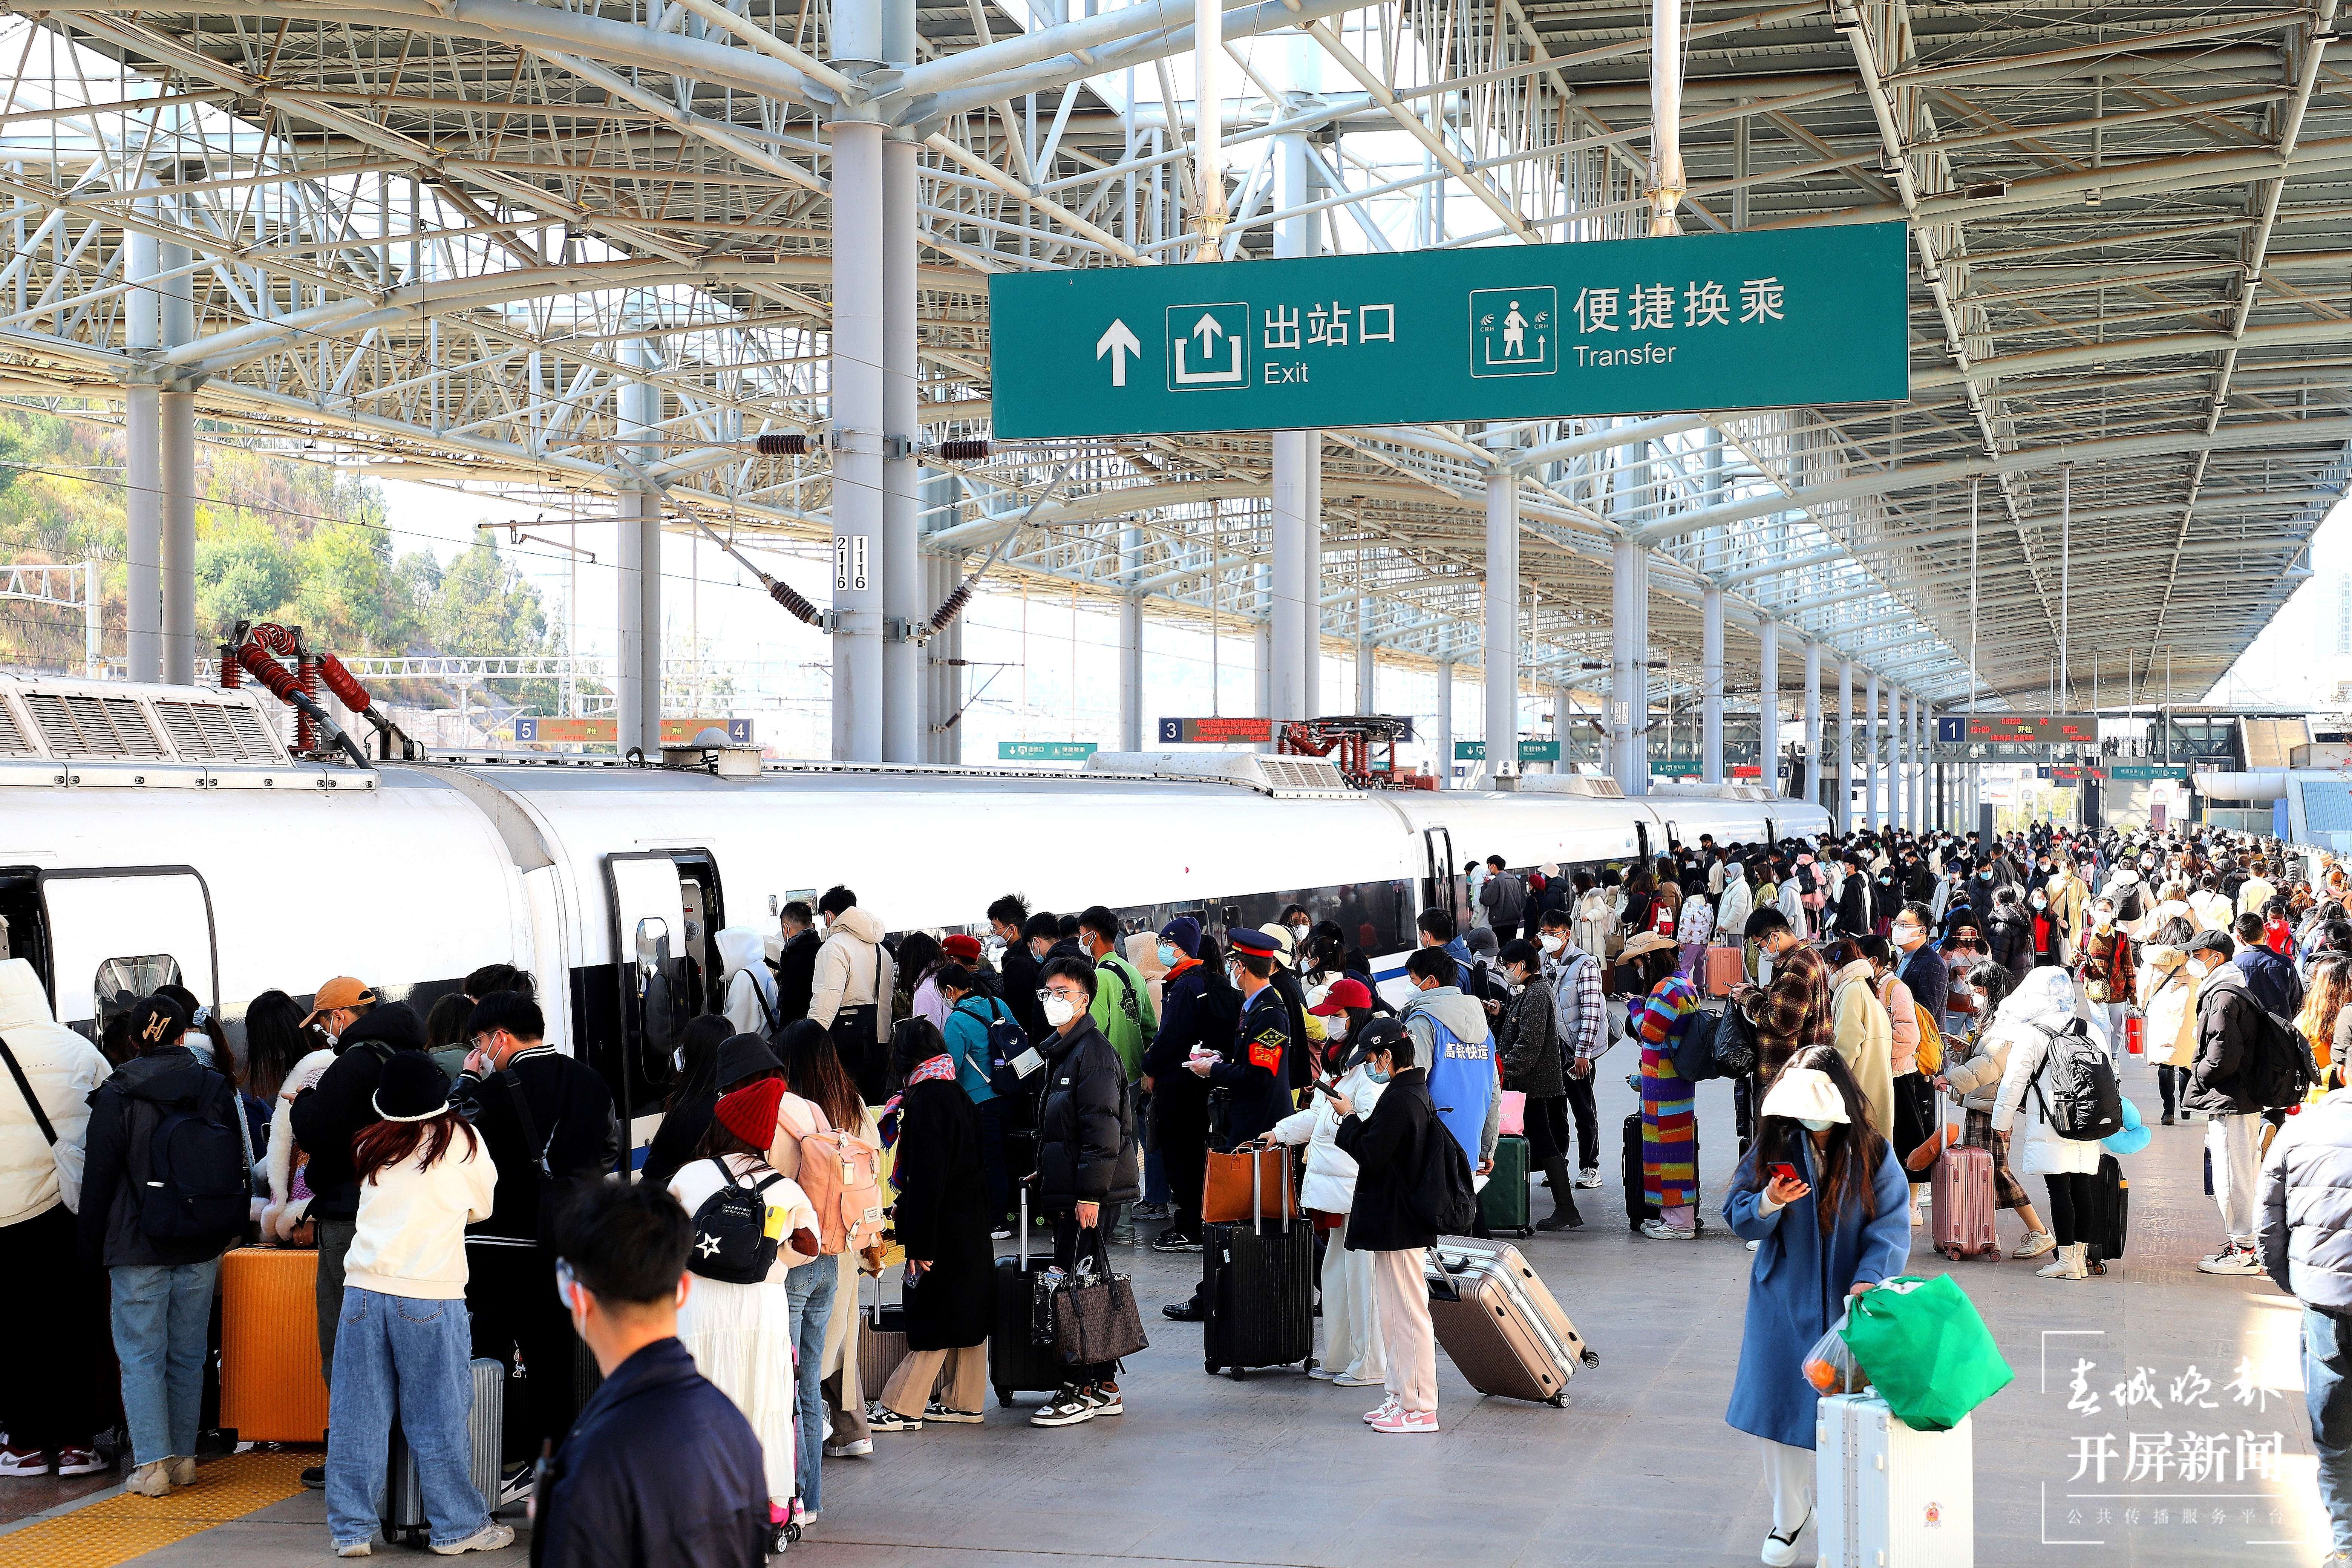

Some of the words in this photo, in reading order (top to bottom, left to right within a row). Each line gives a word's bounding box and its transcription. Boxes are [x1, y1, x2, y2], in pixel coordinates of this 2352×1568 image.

[1572, 276, 1785, 334] 便捷换乘
[1264, 301, 1395, 350] 出站口
[1573, 342, 1677, 367] Transfer
[1264, 361, 1309, 384] Exit
[837, 537, 846, 589] 2116
[855, 537, 866, 589] 1116
[521, 722, 532, 738] 5
[734, 723, 745, 739] 4
[1166, 722, 1177, 738] 3
[1948, 721, 1956, 739] 1
[1781, 768, 1786, 777] 2
[1444, 1042, 1489, 1060] 高铁快运
